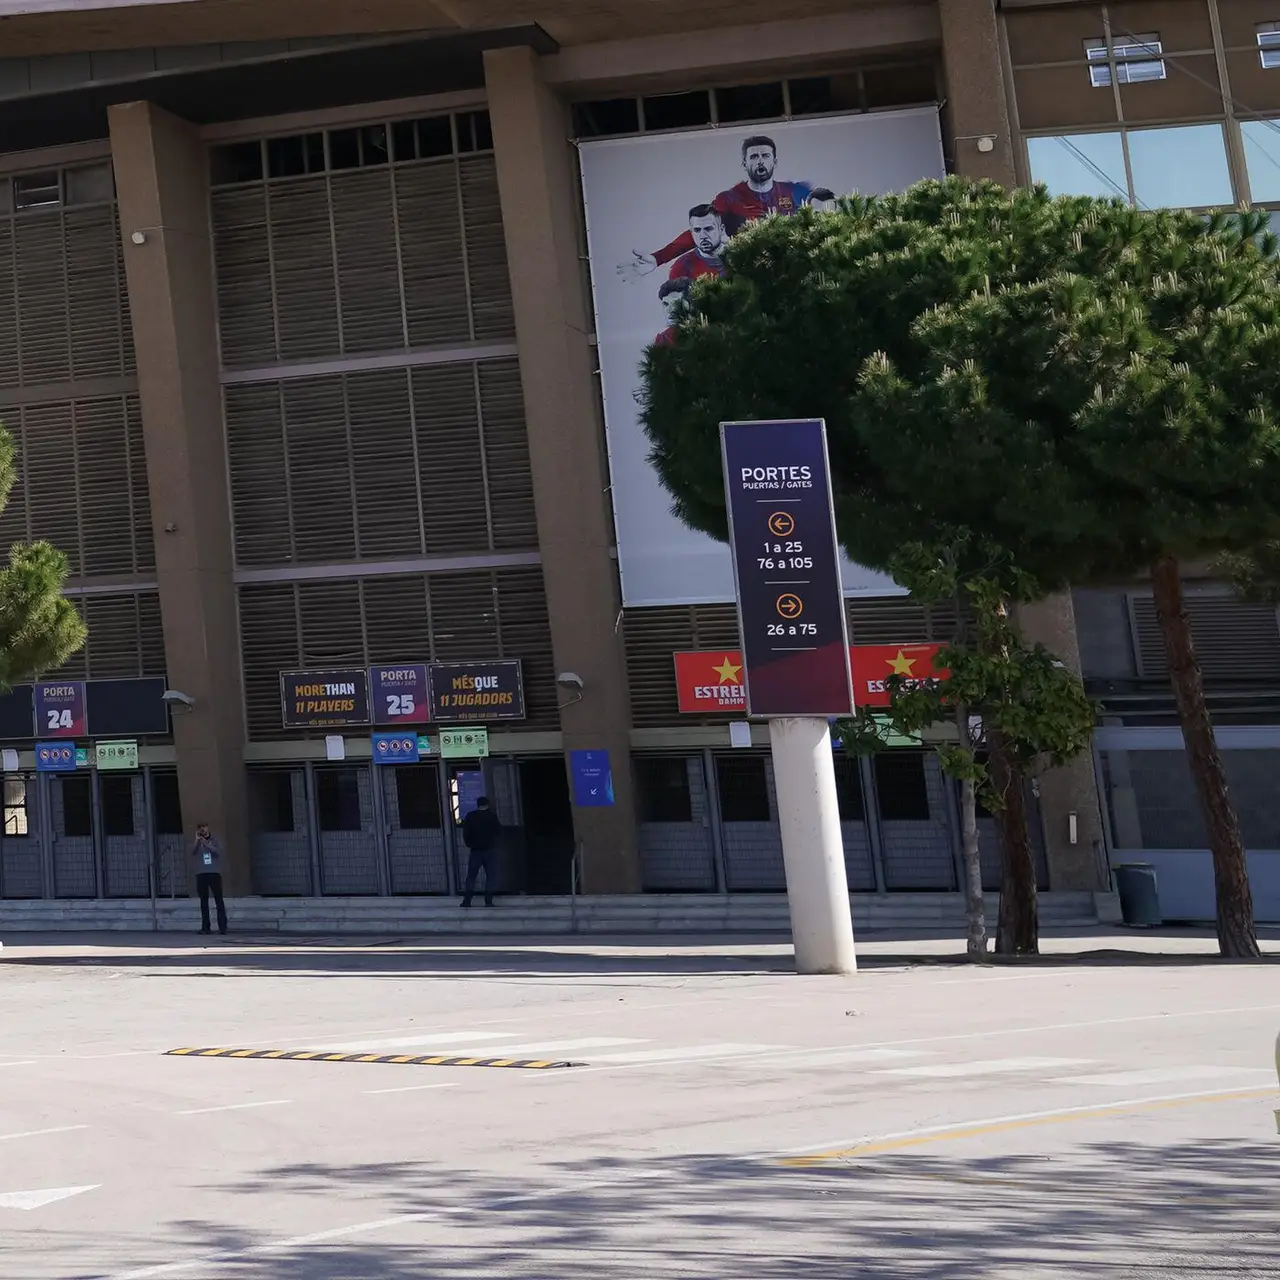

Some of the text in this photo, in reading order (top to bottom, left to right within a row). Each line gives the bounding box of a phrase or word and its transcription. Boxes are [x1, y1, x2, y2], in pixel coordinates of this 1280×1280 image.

[741, 466, 812, 481] PORTES
[742, 481, 780, 490] PUERTAS
[786, 480, 813, 489] GATES
[763, 541, 803, 553] 1 a 25
[756, 557, 813, 570] 76 a 105
[767, 623, 818, 636] 26 a 75
[380, 669, 417, 681] PORTA
[43, 686, 75, 697] PORTA
[296, 699, 355, 713] 11 PLAYERS
[386, 694, 415, 715] 25
[440, 692, 513, 707] 11 JUGADORS
[47, 709, 74, 729] 24
